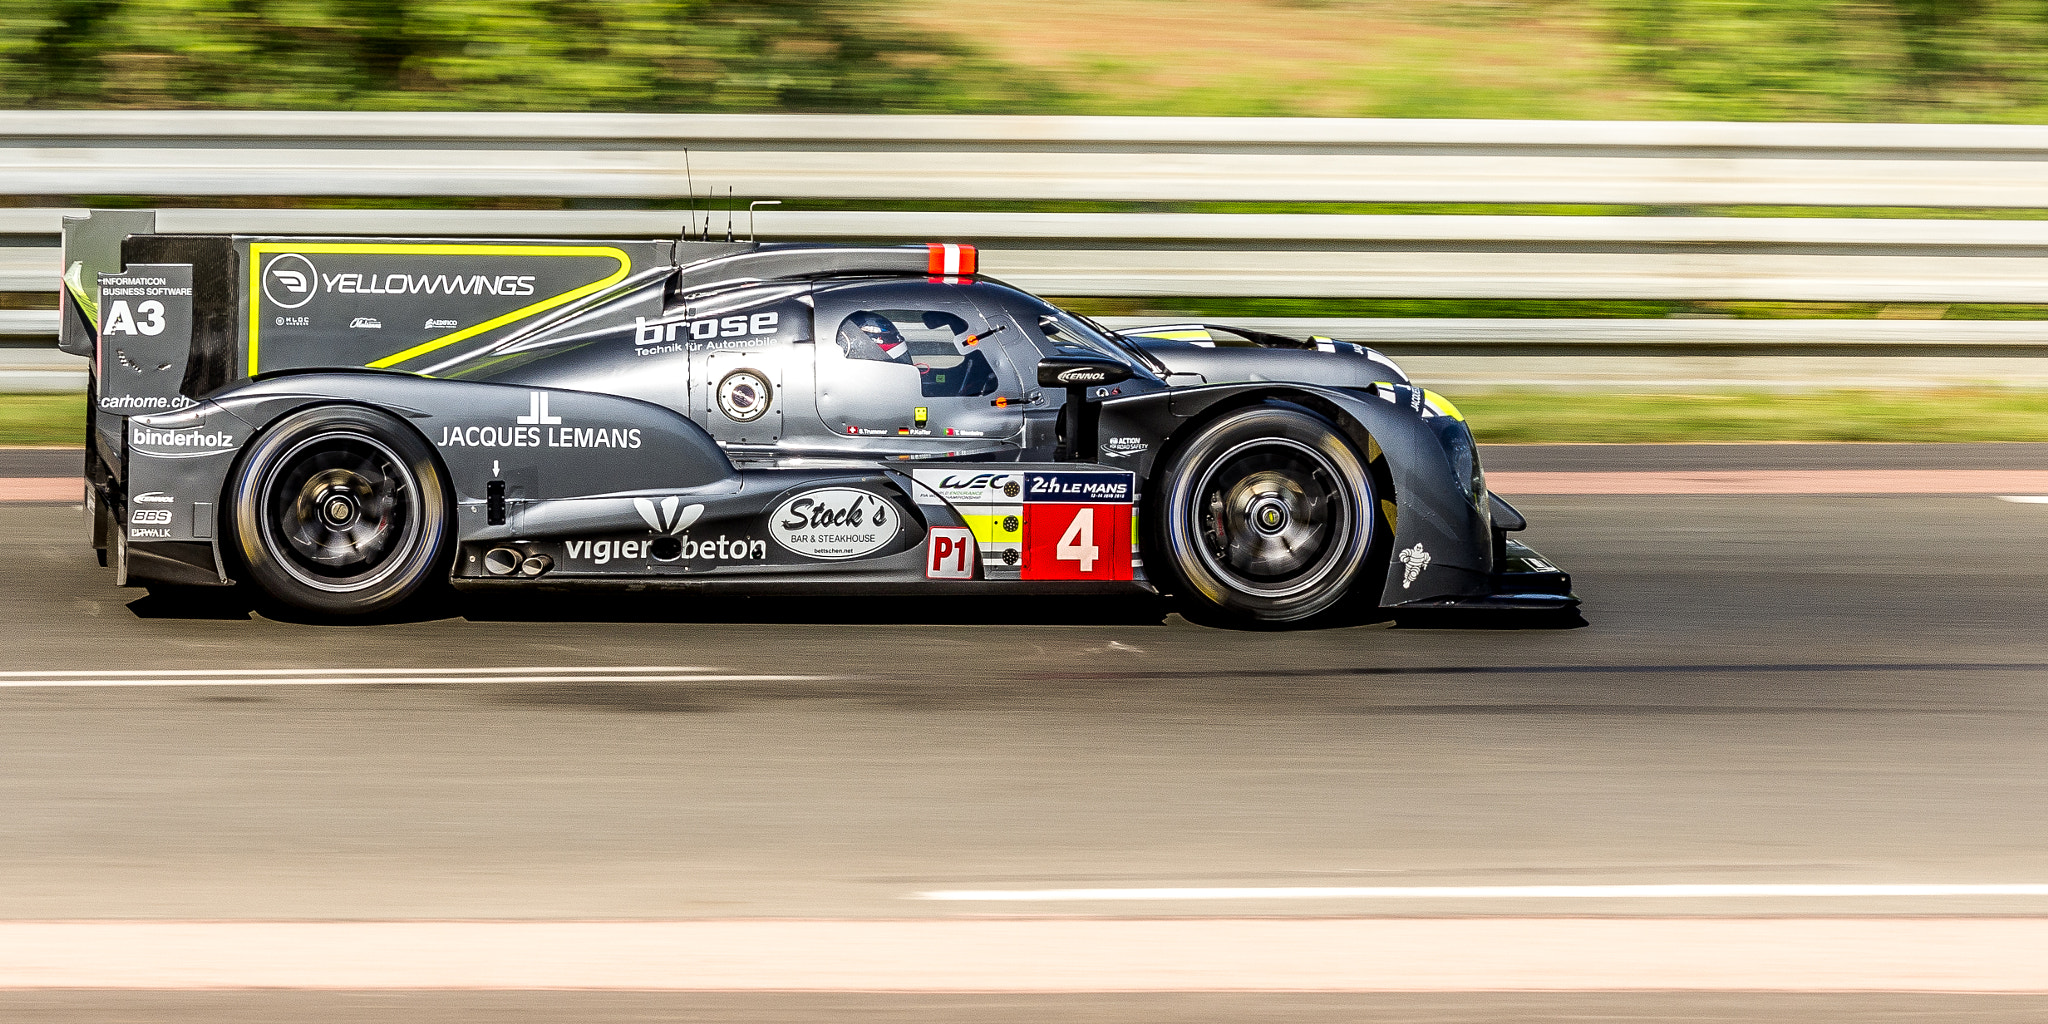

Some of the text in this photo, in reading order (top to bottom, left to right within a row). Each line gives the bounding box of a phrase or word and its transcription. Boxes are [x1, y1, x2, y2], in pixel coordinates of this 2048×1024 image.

[102, 277, 166, 285] INFORMATICON
[322, 273, 536, 296] YELLOWWINGS
[102, 287, 193, 296] BUSINESS SOFTWARE
[102, 300, 166, 336] A3
[634, 311, 779, 346] brose
[634, 336, 778, 357] Technik für Automobile
[1061, 372, 1105, 380] KENNOL
[100, 394, 191, 409] carhome.ch
[133, 428, 234, 447] binderholz
[437, 426, 642, 449] JACQUES LEMANS
[1030, 476, 1061, 493] 24h
[1062, 483, 1128, 494] LE MANS
[133, 511, 170, 521] BBS
[791, 534, 875, 543] BAR & STEAKHOUSE
[1056, 507, 1099, 572] 4
[565, 535, 767, 565] vigier beton
[932, 536, 967, 572] P1
